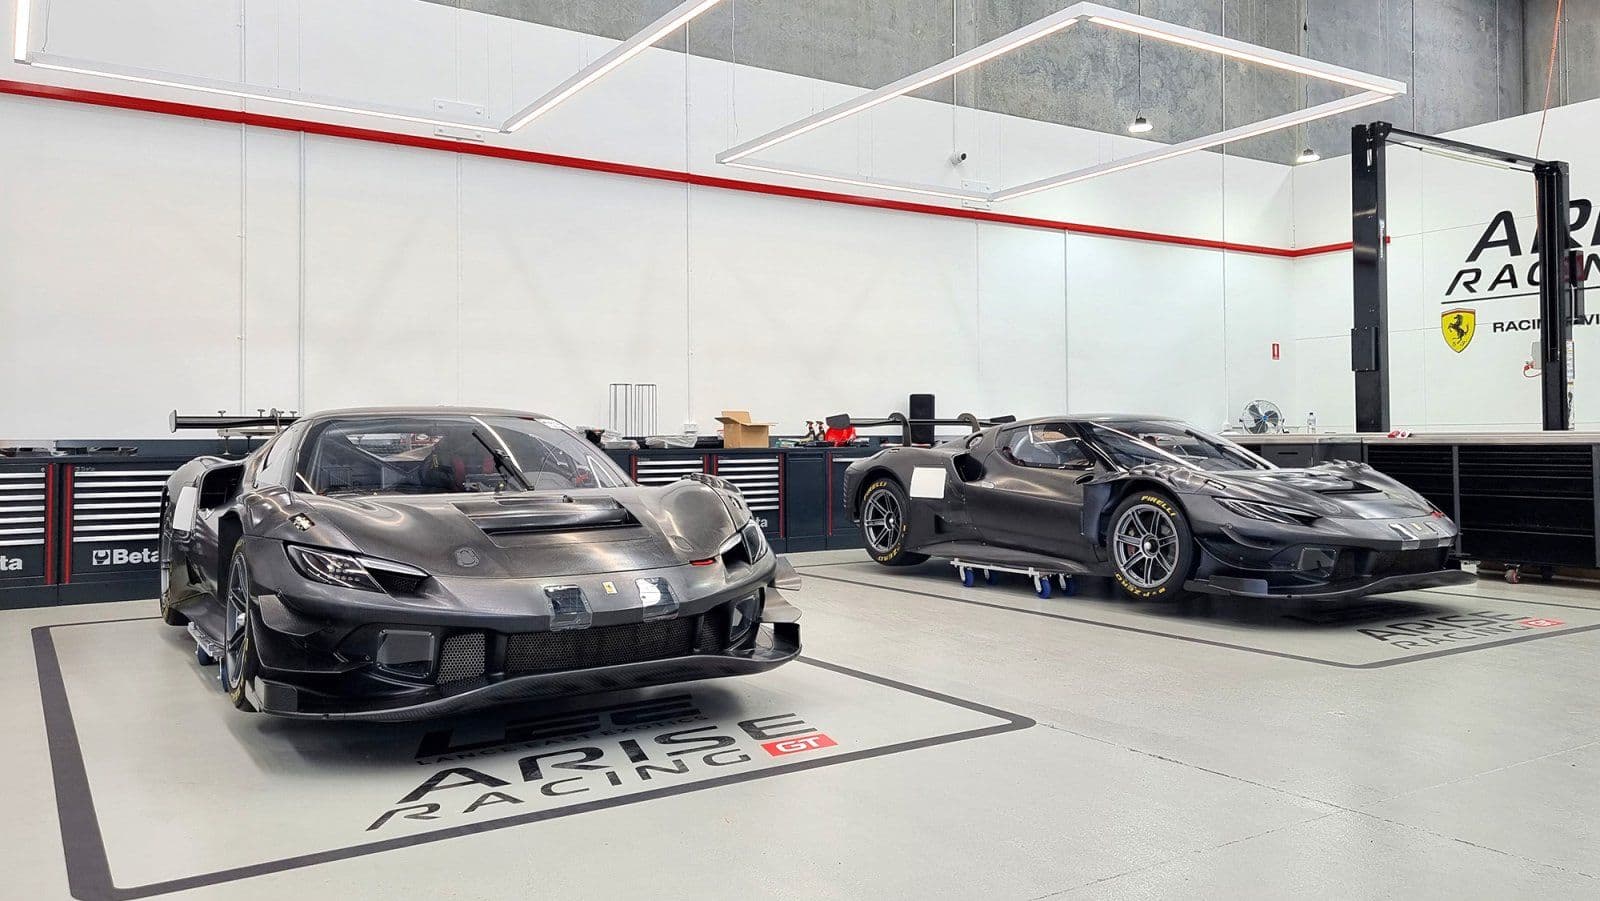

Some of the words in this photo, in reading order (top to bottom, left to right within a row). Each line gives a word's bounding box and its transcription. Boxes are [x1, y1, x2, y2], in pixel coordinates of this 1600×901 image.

[1141, 495, 1176, 517] PIRELLI
[1357, 611, 1530, 641] ARISE
[1391, 623, 1530, 650] RACING
[396, 713, 818, 804] ARISE
[775, 736, 821, 753] GT
[365, 748, 752, 832] RACING
